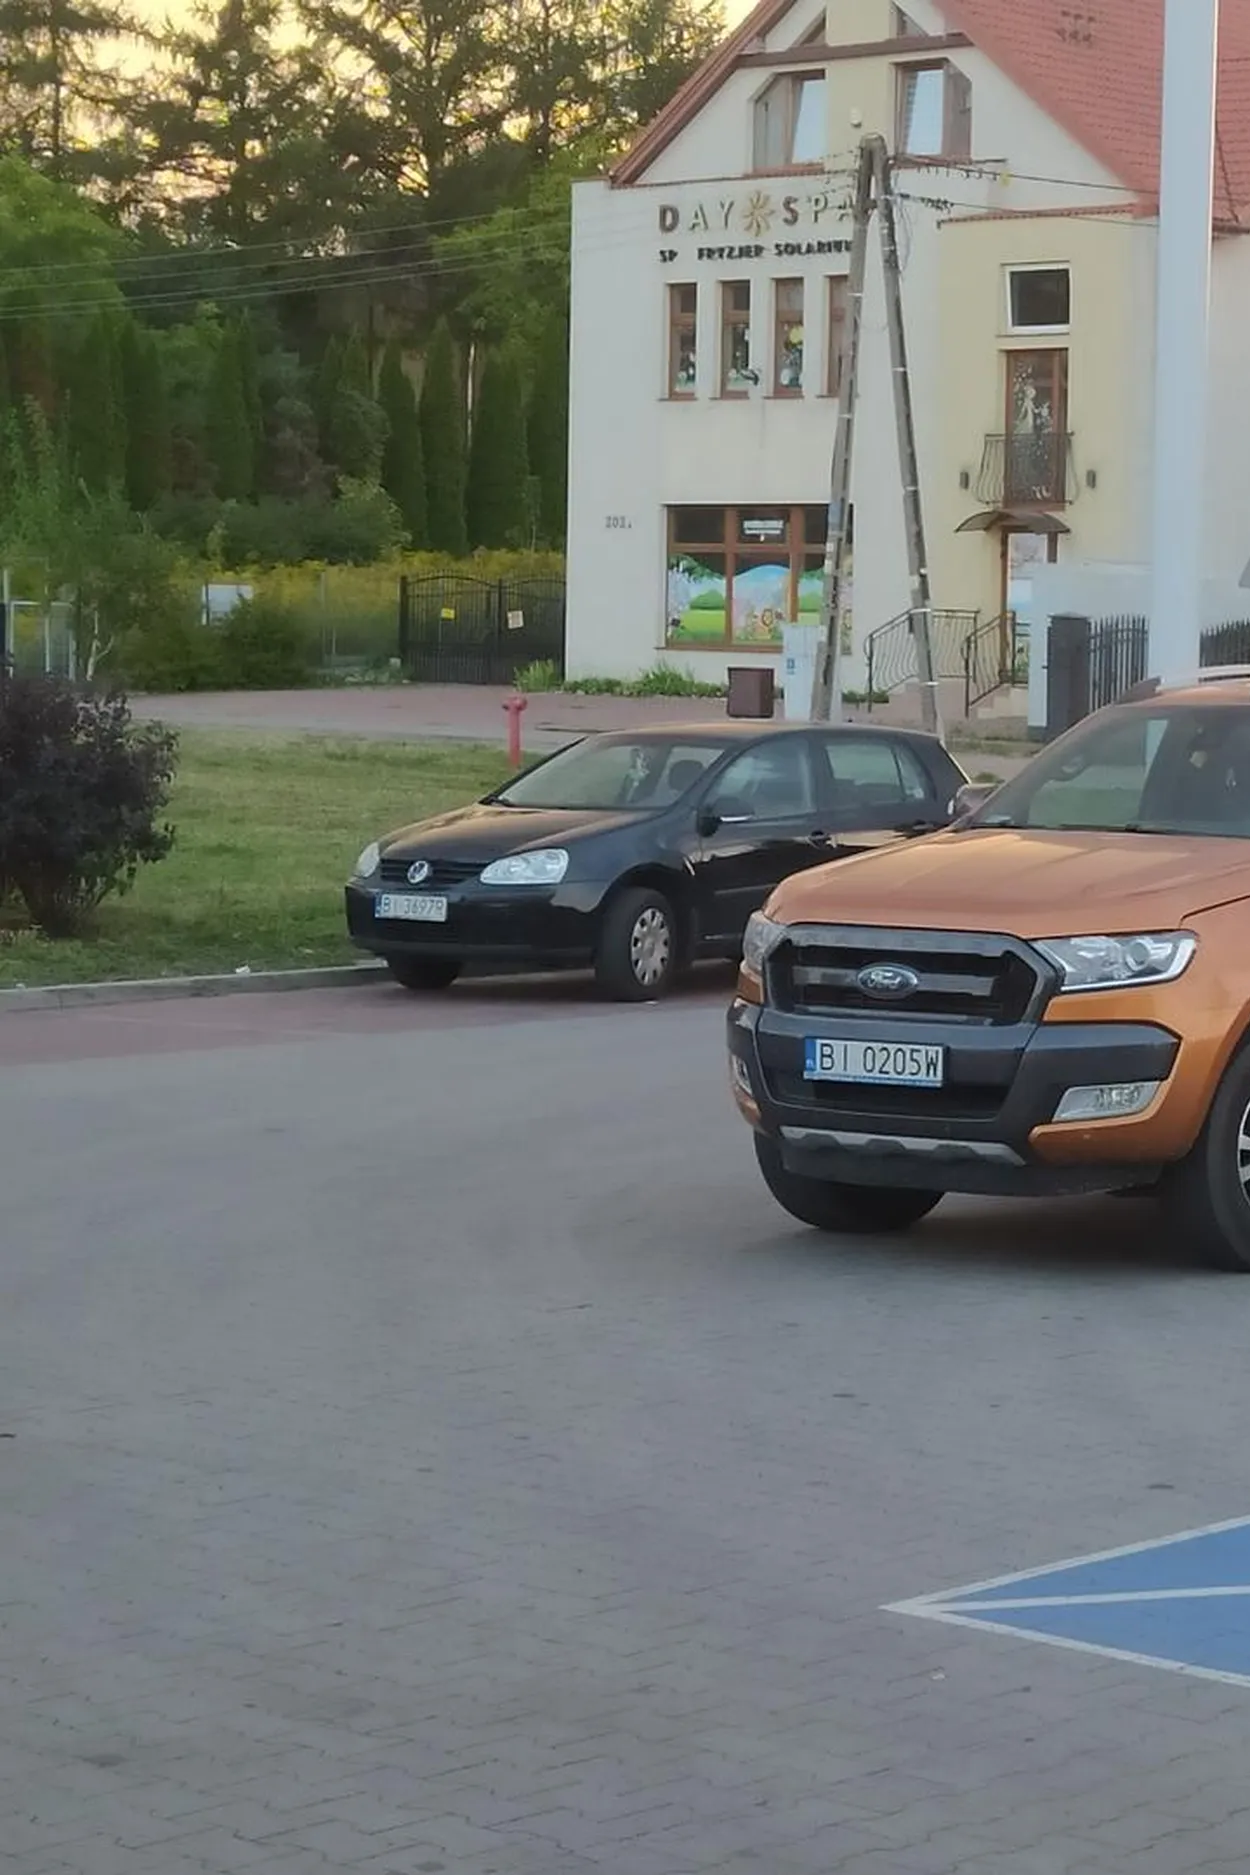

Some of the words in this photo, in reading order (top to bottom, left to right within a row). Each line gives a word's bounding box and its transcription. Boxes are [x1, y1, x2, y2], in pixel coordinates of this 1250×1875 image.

[659, 200, 734, 233] DAY
[782, 192, 855, 227] SPA
[697, 244, 766, 261] FRYZJER
[383, 896, 399, 913] BI
[820, 1043, 848, 1072] BI
[863, 1045, 940, 1078] 0205W
